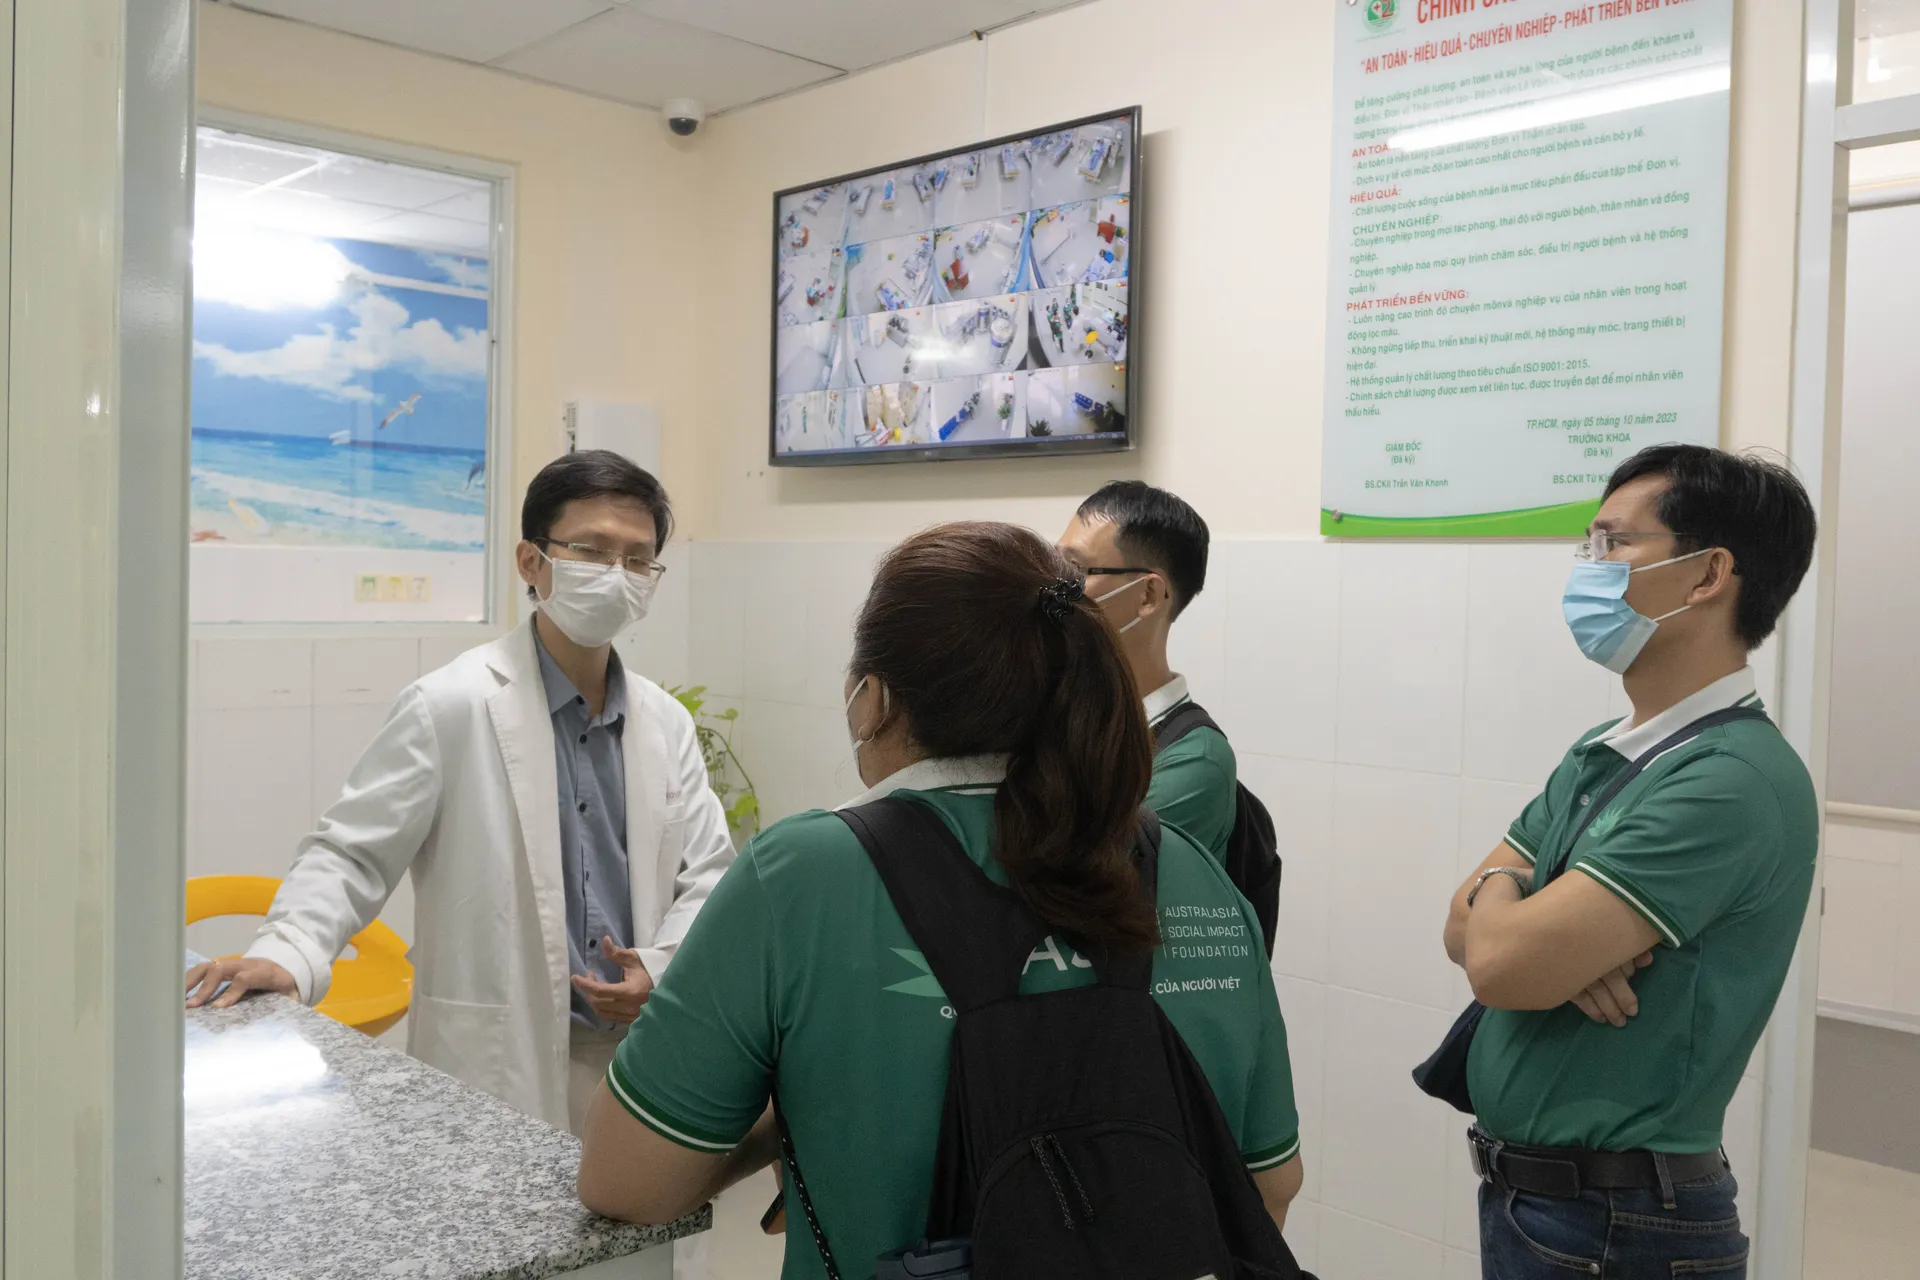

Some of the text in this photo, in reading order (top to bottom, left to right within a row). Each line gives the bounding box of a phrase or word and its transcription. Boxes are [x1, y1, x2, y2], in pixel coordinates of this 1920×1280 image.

[1382, 48, 1408, 70] TOÀN
[1414, 40, 1438, 64] HIỆU
[1441, 32, 1462, 56] QUẢ
[1470, 23, 1512, 50] CHUYÊN
[1516, 13, 1556, 40] NGHIỆP
[1564, 5, 1594, 29] PHÁT
[1352, 220, 1396, 236] CHUYÊN
[1634, 284, 1661, 296] trong
[1346, 298, 1373, 312] PHÁT
[1376, 292, 1407, 308] TRIỂN
[1410, 290, 1432, 304] BỀN
[1624, 320, 1649, 332] trang
[1458, 366, 1476, 378] theo
[1524, 362, 1539, 373] ISO
[1566, 359, 1591, 370] 2015.
[1460, 386, 1477, 394] xem
[1584, 416, 1594, 427] 05
[1596, 416, 1620, 428] tháng
[1624, 414, 1633, 424] 10
[1656, 412, 1678, 424] 2023
[1606, 432, 1630, 442] KHOA
[1165, 905, 1240, 919] AUSTRALASIA
[1168, 924, 1245, 938] SOCIAL IMPACT
[1172, 945, 1249, 959] FOUNDATION
[1155, 978, 1180, 994] CỦA
[1182, 977, 1216, 992] NGƯỜI
[1218, 976, 1240, 991] VIỆT
